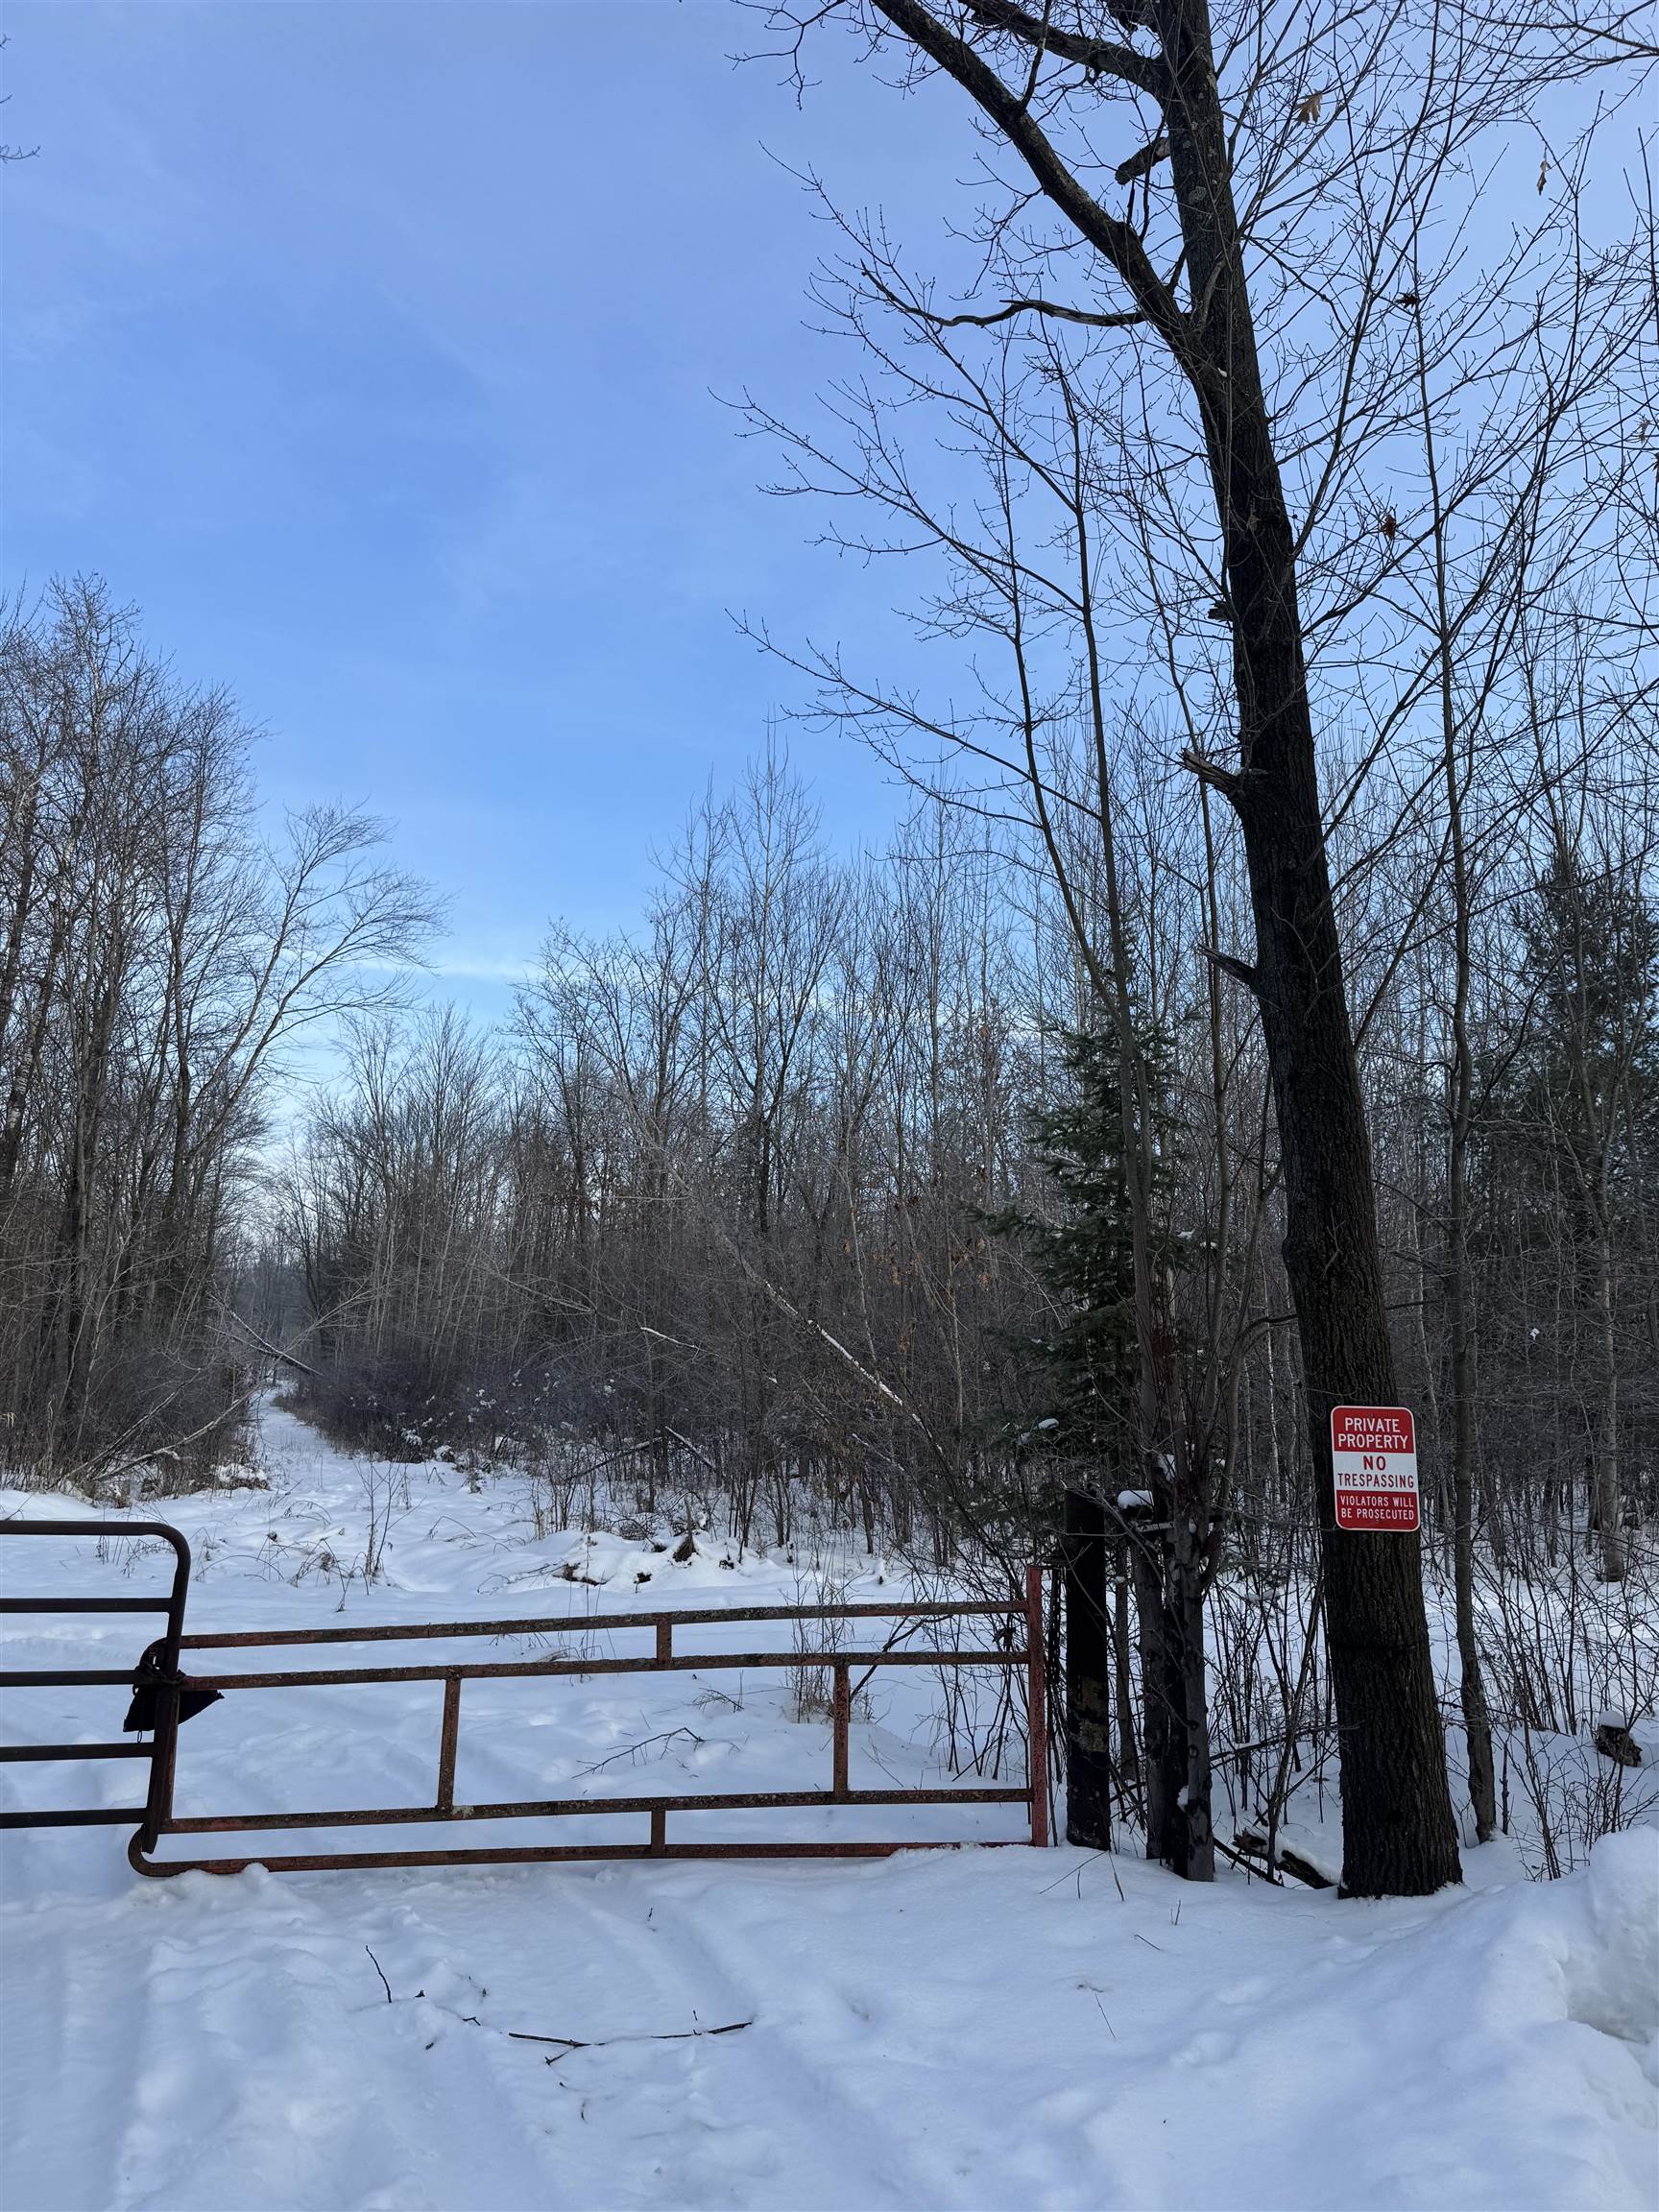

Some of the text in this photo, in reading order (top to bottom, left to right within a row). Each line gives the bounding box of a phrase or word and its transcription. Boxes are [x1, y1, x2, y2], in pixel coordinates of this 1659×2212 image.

[1345, 1417, 1401, 1432] PRIVATE
[1338, 1433, 1407, 1449] PROPERTY
[1363, 1455, 1386, 1470] NO
[1337, 1474, 1414, 1488] TRESPASSING
[1340, 1495, 1414, 1507] VIOLATORS WILL
[1341, 1508, 1414, 1520] BE PROSECUTED
